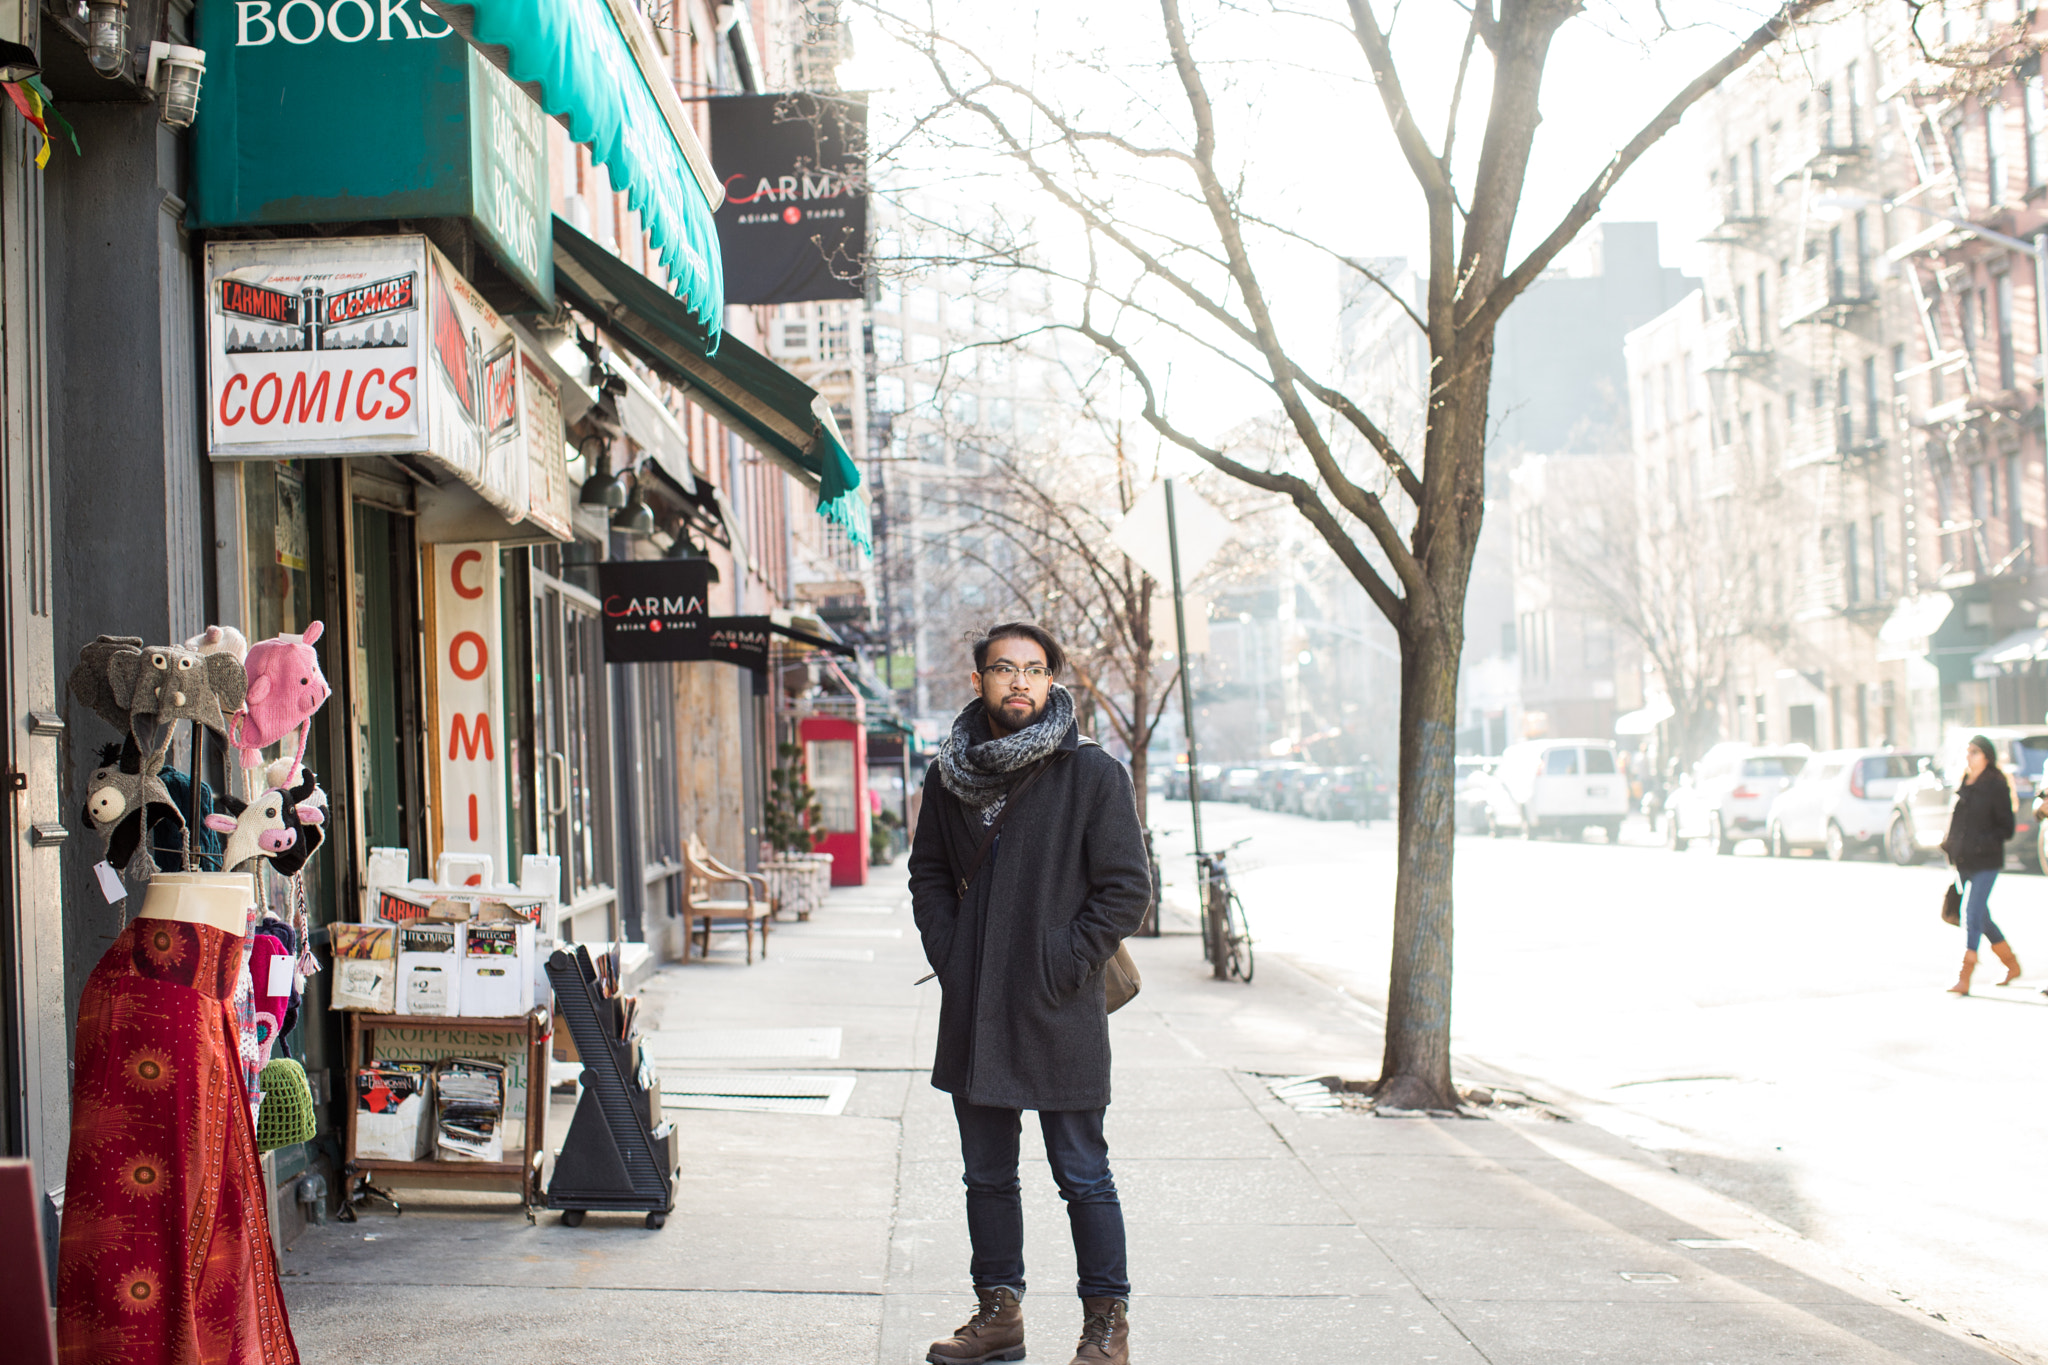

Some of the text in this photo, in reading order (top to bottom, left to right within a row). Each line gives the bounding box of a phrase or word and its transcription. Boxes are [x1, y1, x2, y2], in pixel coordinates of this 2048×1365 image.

[235, 0, 454, 46] BOOKS
[494, 164, 538, 277] BOOKS
[303, 273, 334, 281] STREET
[222, 281, 287, 322] CARMINE
[219, 366, 417, 426] COMICS
[604, 594, 705, 617] CARMA
[615, 621, 697, 632] ASIAN TAPAS
[710, 629, 768, 647] ARMA
[448, 549, 495, 887] COMI
[380, 894, 429, 922] CARMIN
[376, 1028, 526, 1047] NOPPRESSIV
